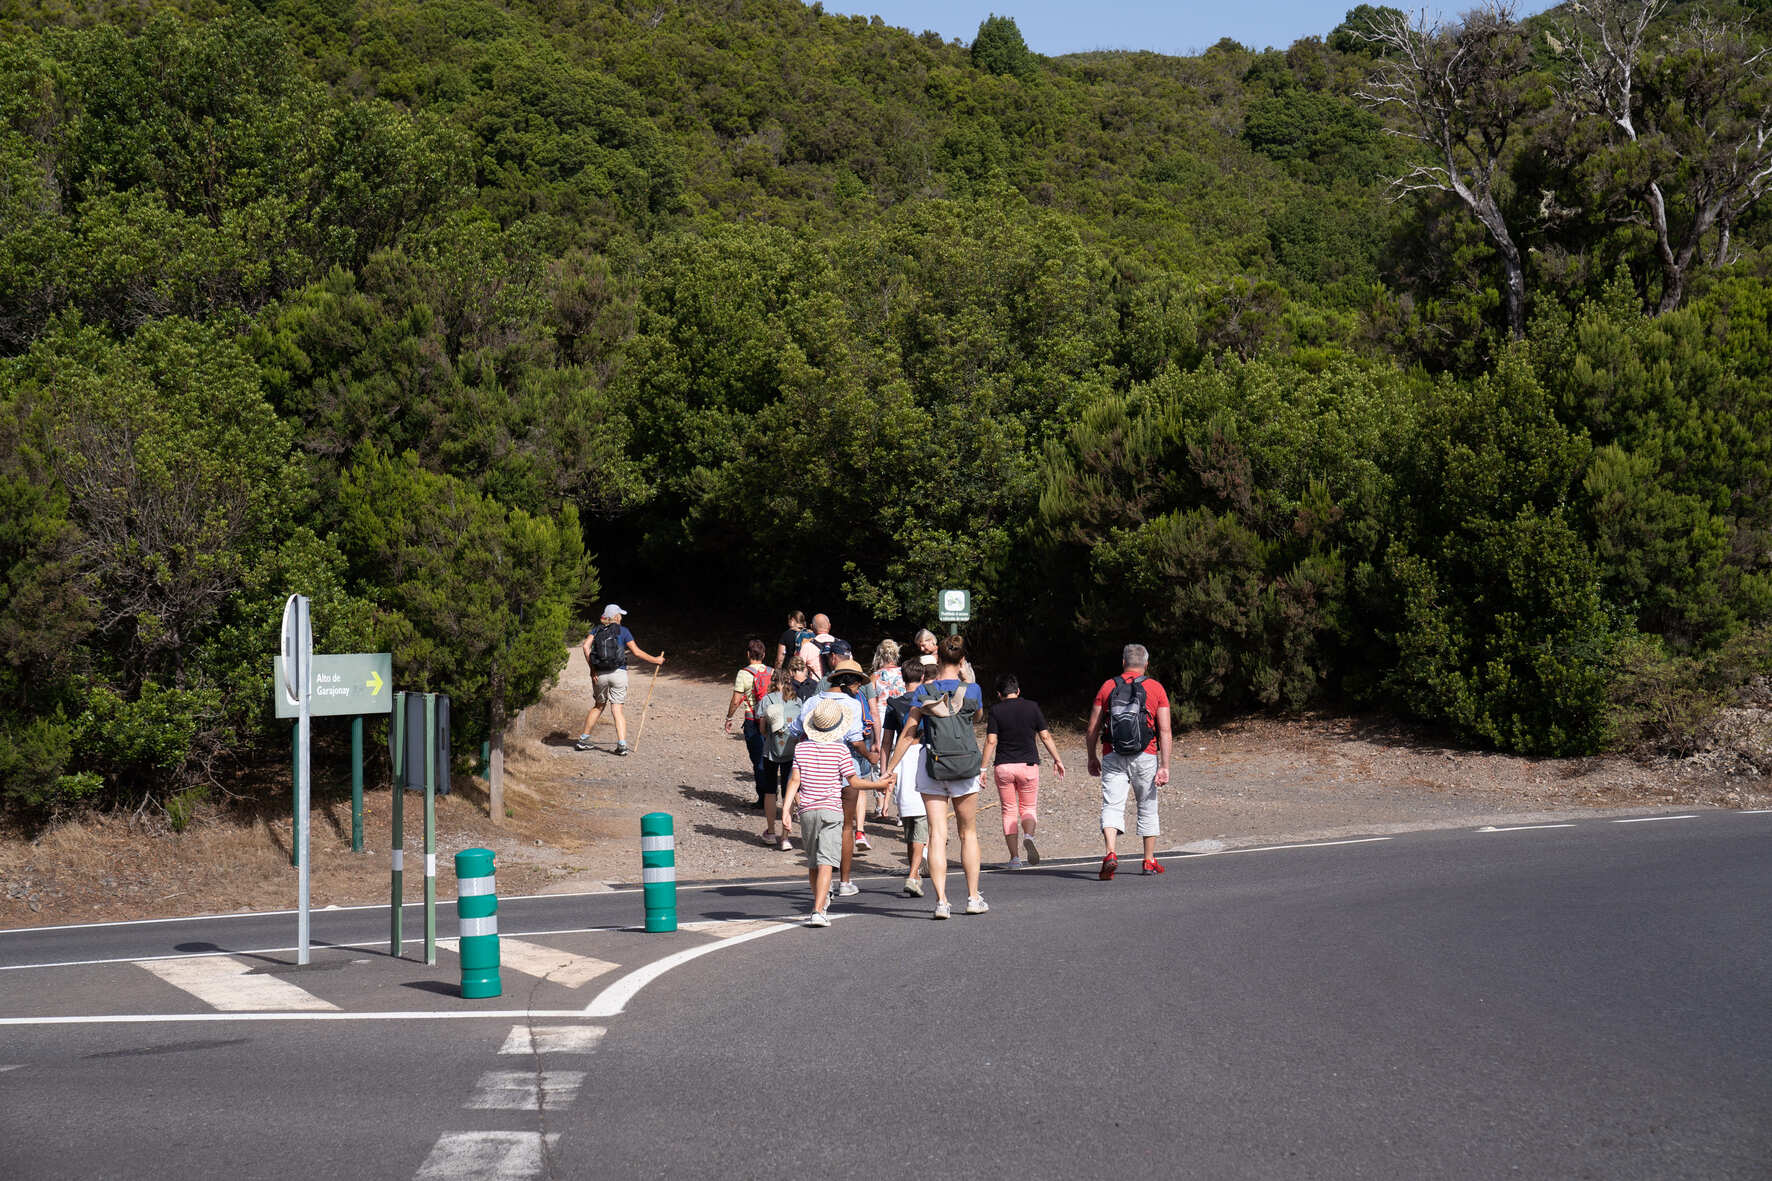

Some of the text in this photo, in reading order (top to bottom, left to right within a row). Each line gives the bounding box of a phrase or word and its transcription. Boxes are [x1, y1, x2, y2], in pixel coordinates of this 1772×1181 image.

[316, 673, 341, 683] Alto de
[316, 685, 350, 697] Garajonay
